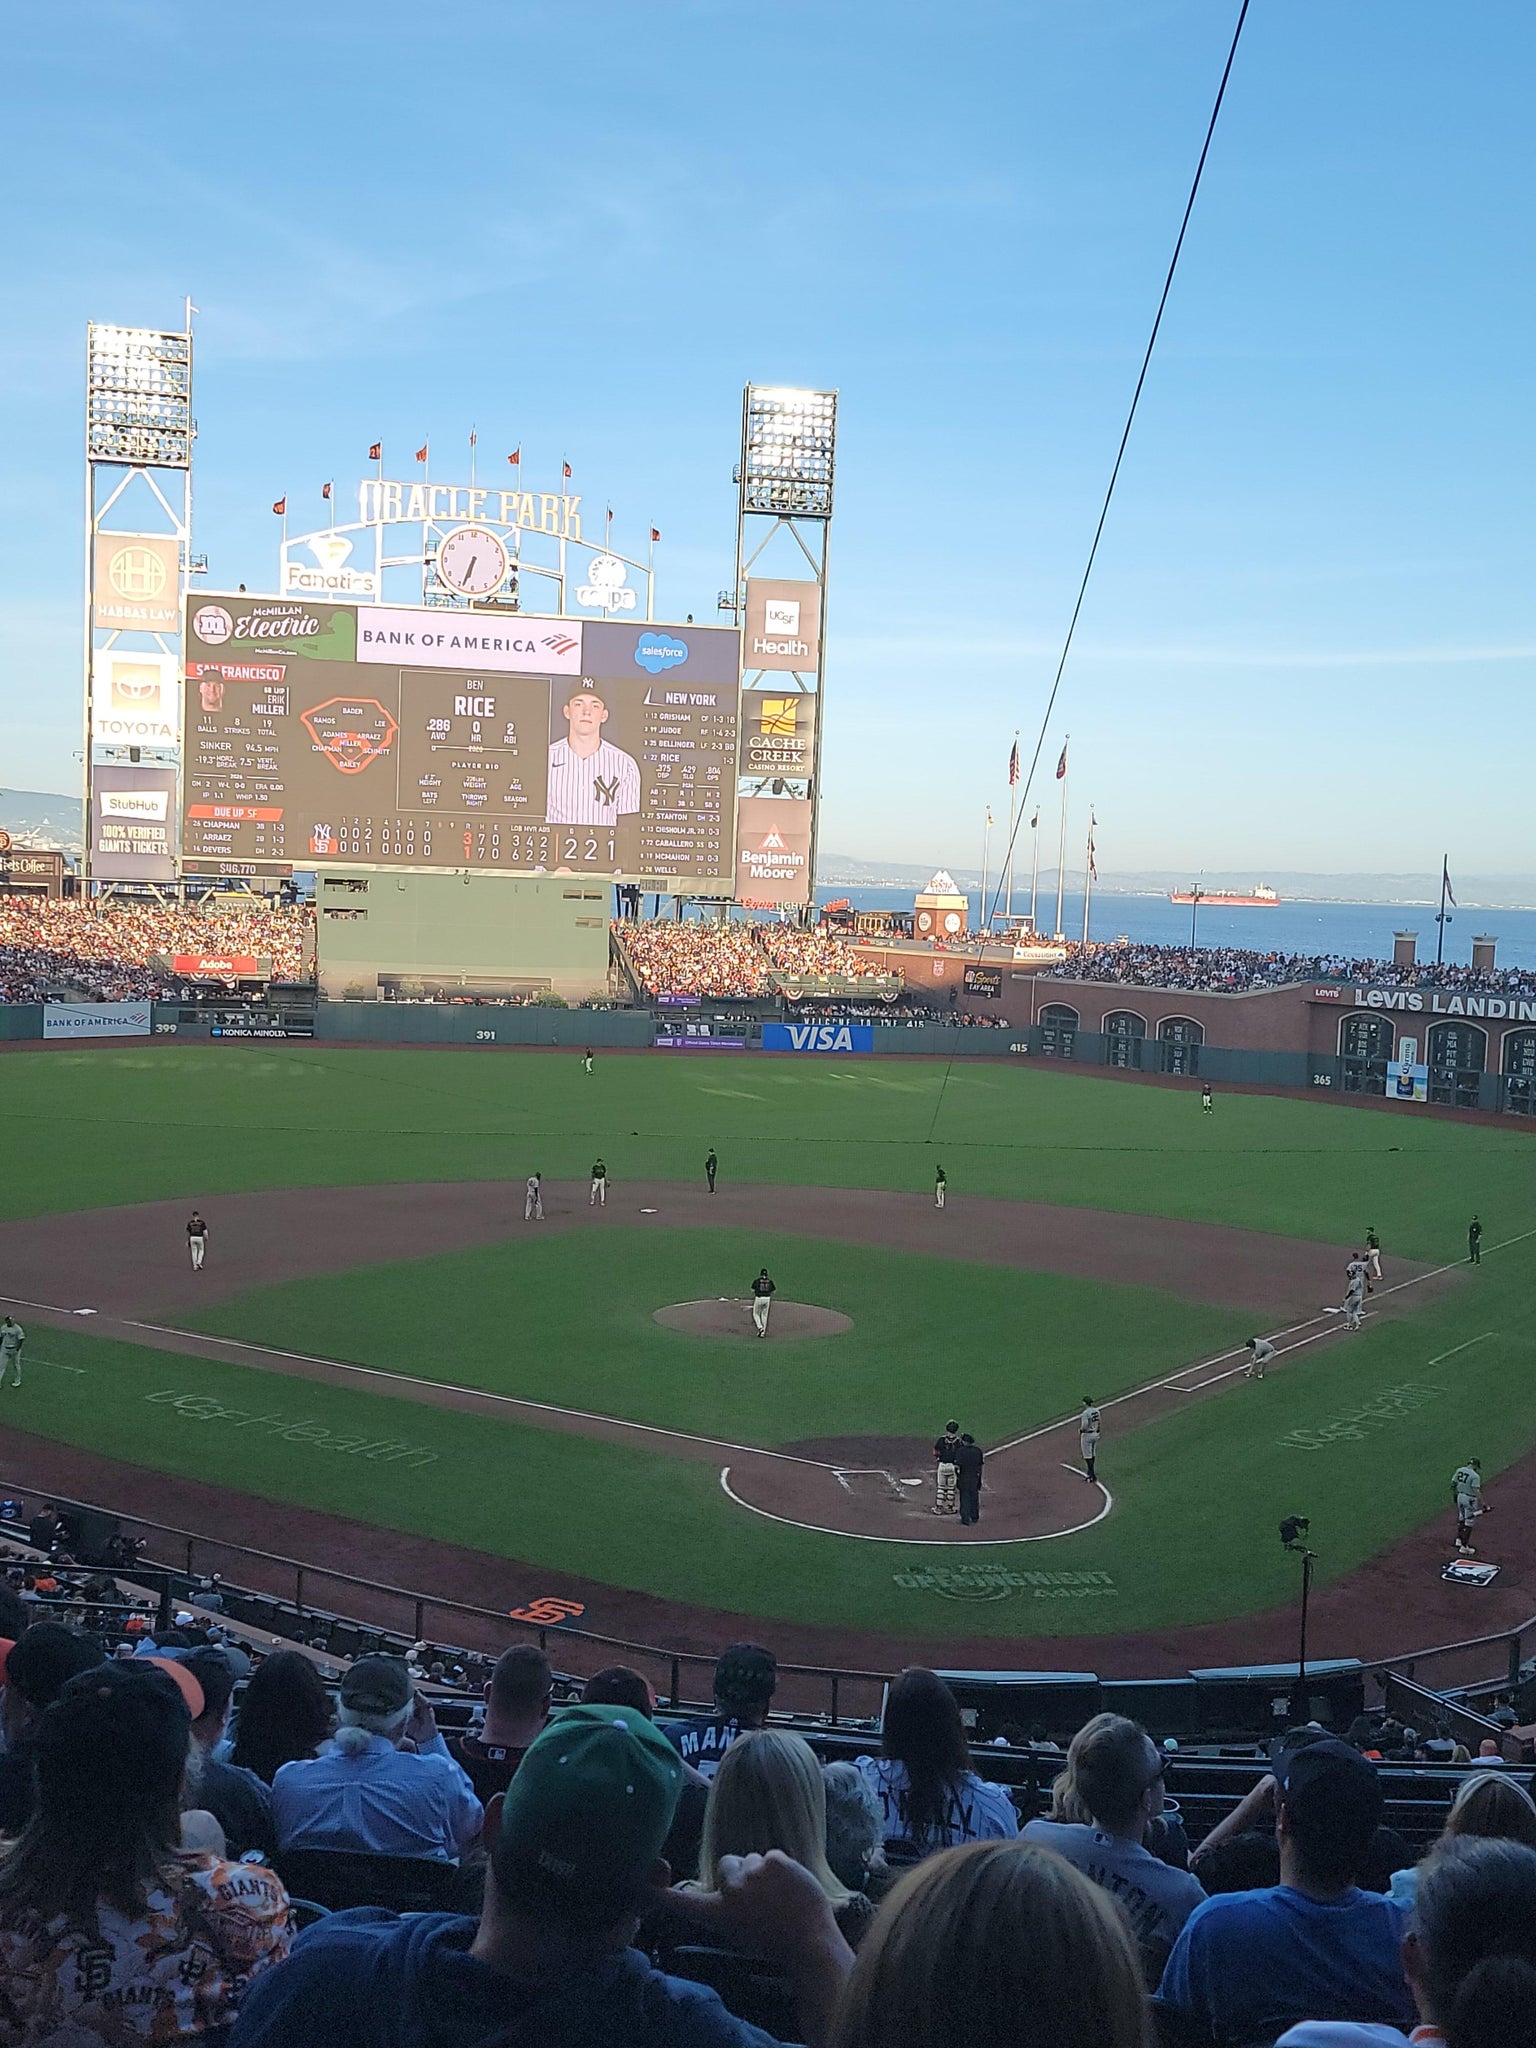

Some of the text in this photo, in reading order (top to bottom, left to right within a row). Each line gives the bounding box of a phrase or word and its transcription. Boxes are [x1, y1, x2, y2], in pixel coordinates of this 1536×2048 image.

[359, 480, 583, 541] ORACLE PARK
[289, 568, 374, 592] Fanatics
[99, 605, 176, 621] HABBAS LAW
[253, 606, 302, 616] McMILLAN
[769, 610, 795, 625] UCSF
[235, 615, 319, 638] Electric
[363, 630, 536, 653] BANK OF AMERICA
[754, 638, 808, 656] Health
[642, 647, 683, 658] salesforce
[222, 666, 279, 680] FRANCISCO
[467, 680, 483, 690] BEN
[268, 695, 285, 704] ERIK
[666, 692, 716, 706] NEW YORK
[253, 704, 284, 715] MILLER
[454, 696, 495, 717] RICE
[203, 716, 212, 724] 11
[427, 719, 450, 732] .286
[713, 716, 724, 724] 1-3
[99, 720, 171, 737] TOYOTA
[258, 728, 277, 736] TOTAL
[472, 721, 480, 733] 0
[506, 723, 514, 734] 2
[659, 727, 681, 735] JUDGE
[471, 734, 482, 742] HR
[504, 736, 517, 744] RBI
[749, 736, 806, 751] CACHE
[200, 741, 232, 751] SINKER
[245, 744, 262, 752] 94.5
[659, 741, 695, 749] BELLINGER
[660, 753, 680, 762] RICE
[750, 750, 803, 763] CREEK
[656, 764, 671, 772] .375
[681, 766, 696, 774] .429
[748, 763, 805, 773] CASINO RESORT
[463, 781, 487, 789] WEIGHT
[593, 775, 620, 806] NY
[110, 797, 158, 811] StubHub
[214, 807, 258, 818] DUE UP SF
[656, 813, 687, 821] STANTON
[203, 821, 240, 830] CHAPMAN
[102, 824, 165, 840] 100% VERIFIED
[314, 824, 332, 839] NY
[203, 834, 232, 842] ARRAEZ
[99, 838, 168, 855] GIANTS TICKETS
[564, 838, 615, 861] 2 2 1
[655, 840, 693, 848] CABALLERO
[203, 846, 284, 856] DEVERS 2-3
[655, 853, 690, 861] MCMAHON
[741, 850, 804, 867] Benjamin
[21, 858, 45, 873] Coffee
[220, 864, 256, 874] $46,770
[654, 866, 677, 874] WELLS
[750, 864, 797, 879] Moore
[776, 901, 803, 910] LIGHT
[199, 959, 233, 971] Adobe
[975, 972, 1001, 985] Sports
[47, 1018, 128, 1028] BANK OF AMERICA
[156, 1023, 177, 1034] 399
[222, 1028, 287, 1038] KONICA MINOLTA
[476, 1031, 496, 1041] 391
[784, 1026, 853, 1050] VISA
[1009, 1043, 1028, 1053] 415
[1402, 1044, 1411, 1074] Corona
[1313, 1074, 1331, 1086] 365
[1457, 1471, 1469, 1483] 27
[216, 1878, 279, 1900] GIANTS
